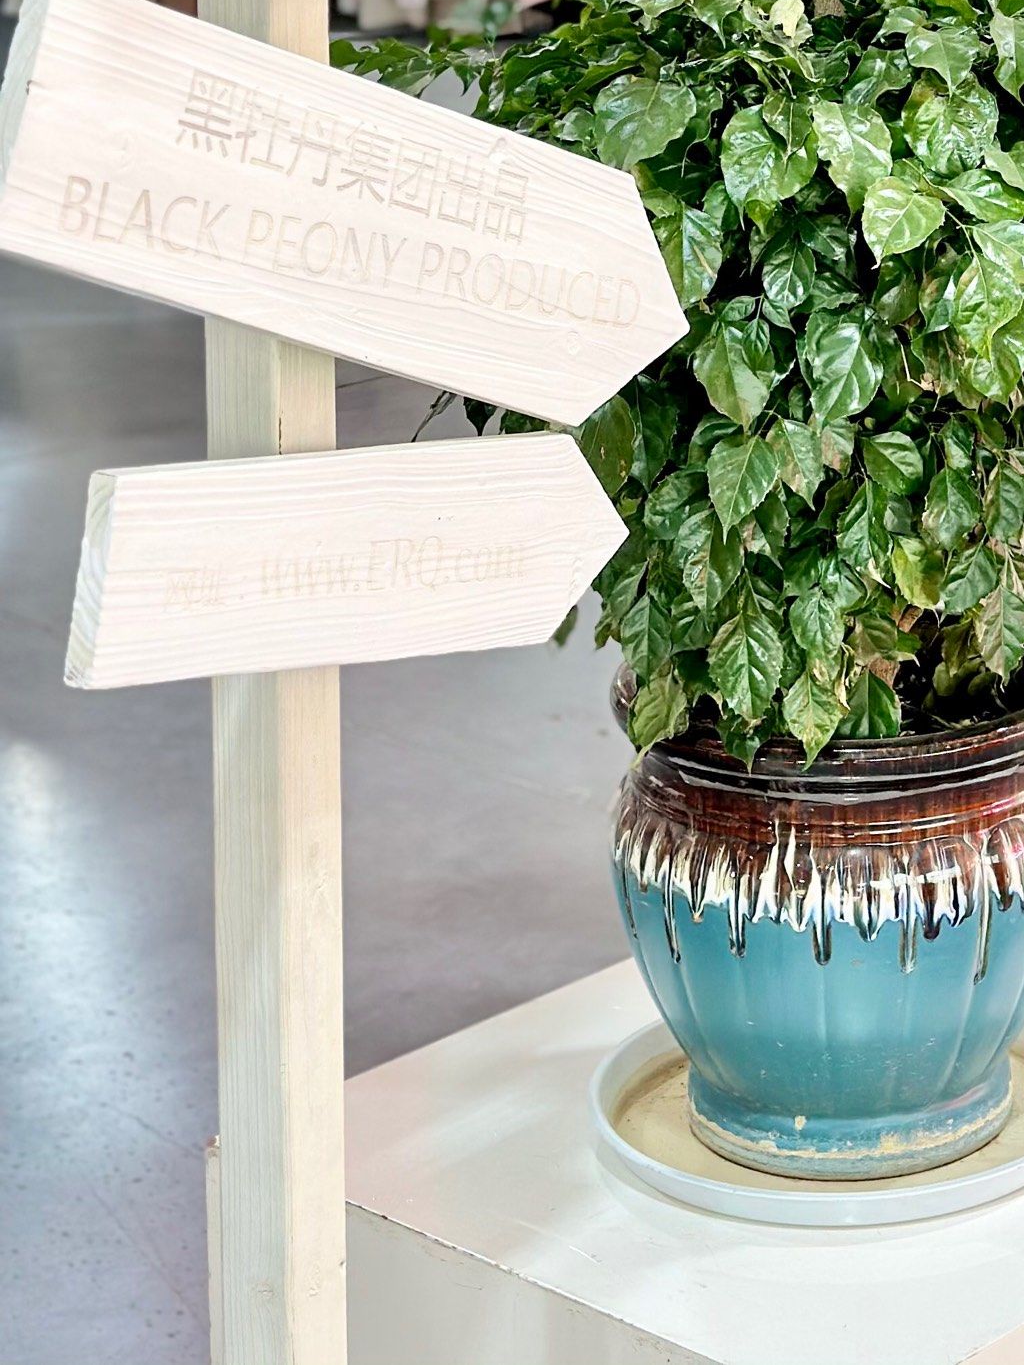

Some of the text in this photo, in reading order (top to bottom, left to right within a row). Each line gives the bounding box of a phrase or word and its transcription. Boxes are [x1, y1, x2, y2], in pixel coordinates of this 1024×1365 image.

[174, 68, 531, 245] 黑牡丹集团出品
[56, 173, 643, 332] BLACK PEONY PRODUCED
